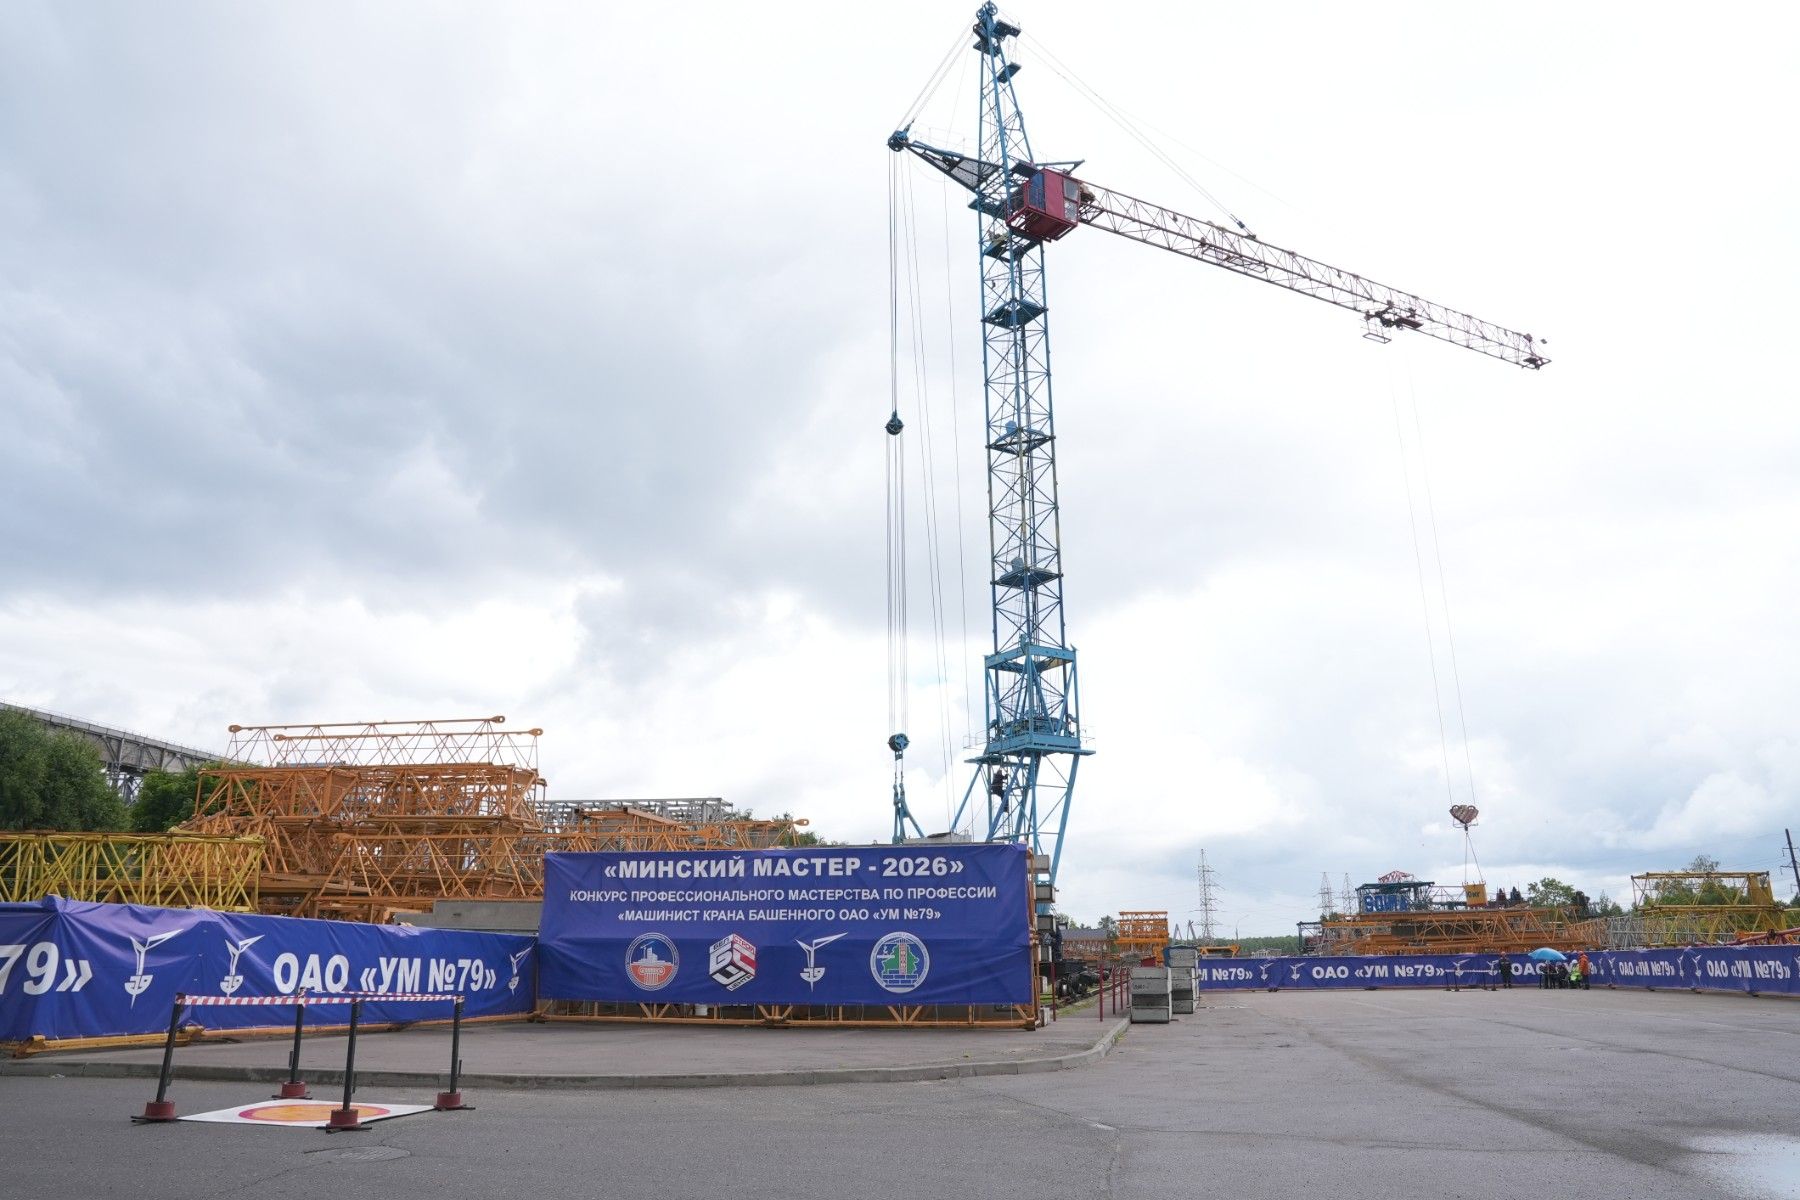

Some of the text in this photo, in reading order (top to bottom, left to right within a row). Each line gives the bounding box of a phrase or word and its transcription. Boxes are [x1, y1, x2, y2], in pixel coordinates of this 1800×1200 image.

[604, 855, 745, 878] «МИНСКИЙ
[753, 858, 861, 877] МАСТЕР
[882, 856, 964, 877] 2026»
[570, 886, 997, 902] КОНКУРС ПРОФЕССИОНАЛЬНОГО МАСТЕРСТВА ПО ПРОФЕССИИ
[617, 907, 941, 922] «МАШИНИСТ КРАНА БАШЕННОГО ОАО «УМ №79»
[273, 952, 497, 995] ОАО «УМ №79»
[1211, 967, 1253, 981] №79»
[1312, 964, 1445, 979] ОАО «УМ №79»
[1618, 961, 1635, 976] ОАО
[1706, 960, 1791, 979] ОАО «УМ №79»
